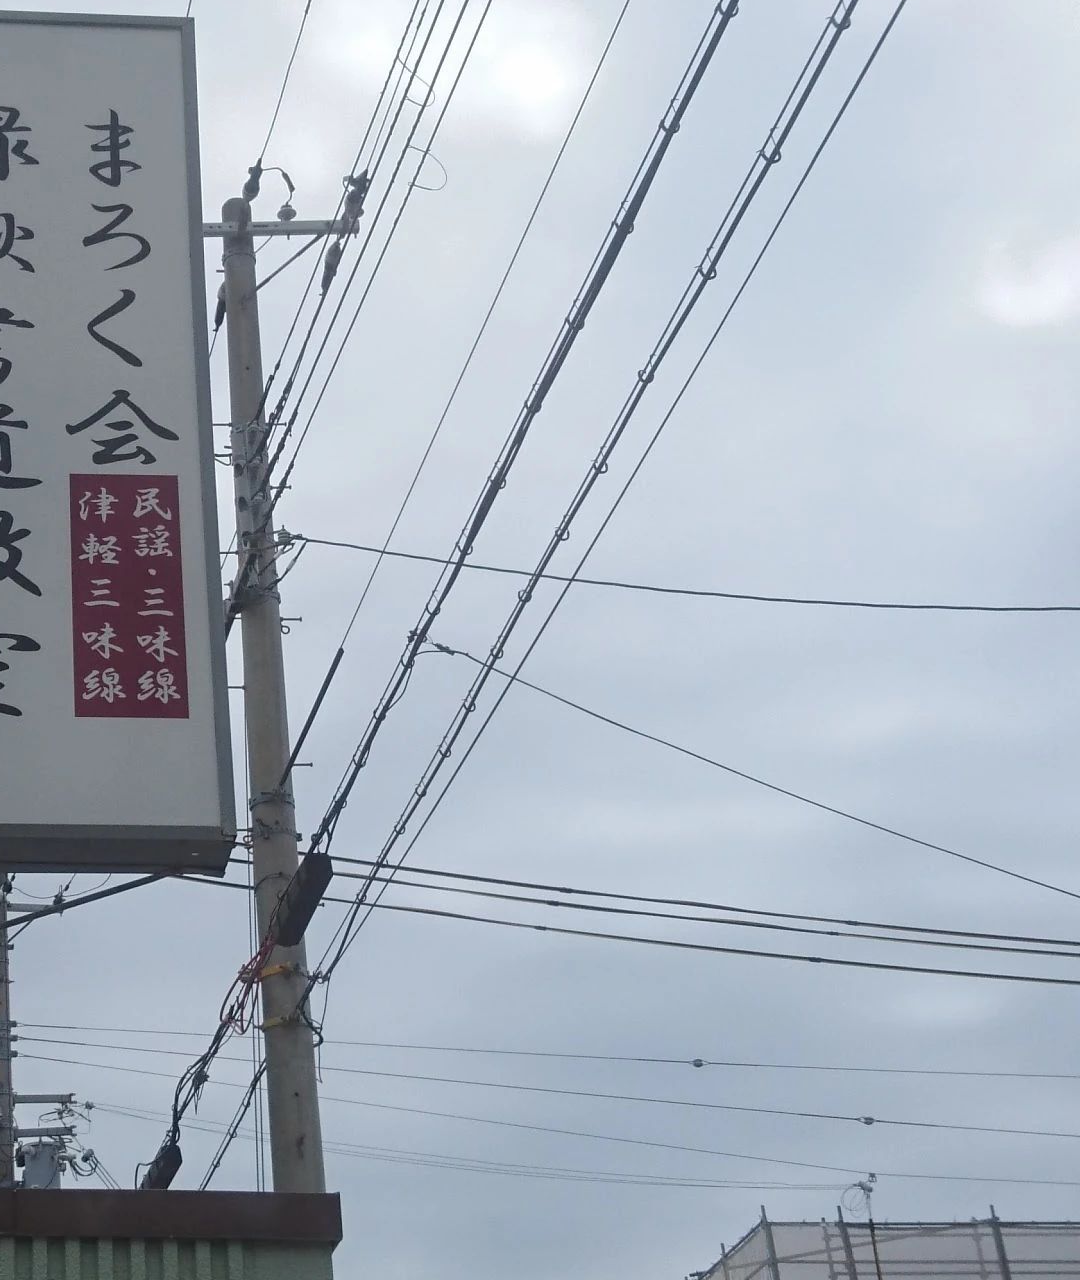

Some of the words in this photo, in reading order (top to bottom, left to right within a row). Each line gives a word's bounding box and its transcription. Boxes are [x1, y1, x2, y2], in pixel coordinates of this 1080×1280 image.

[65, 108, 181, 466] まろく会
[78, 487, 127, 704] 津軽三味線
[131, 487, 181, 705] 民謡・三味線
